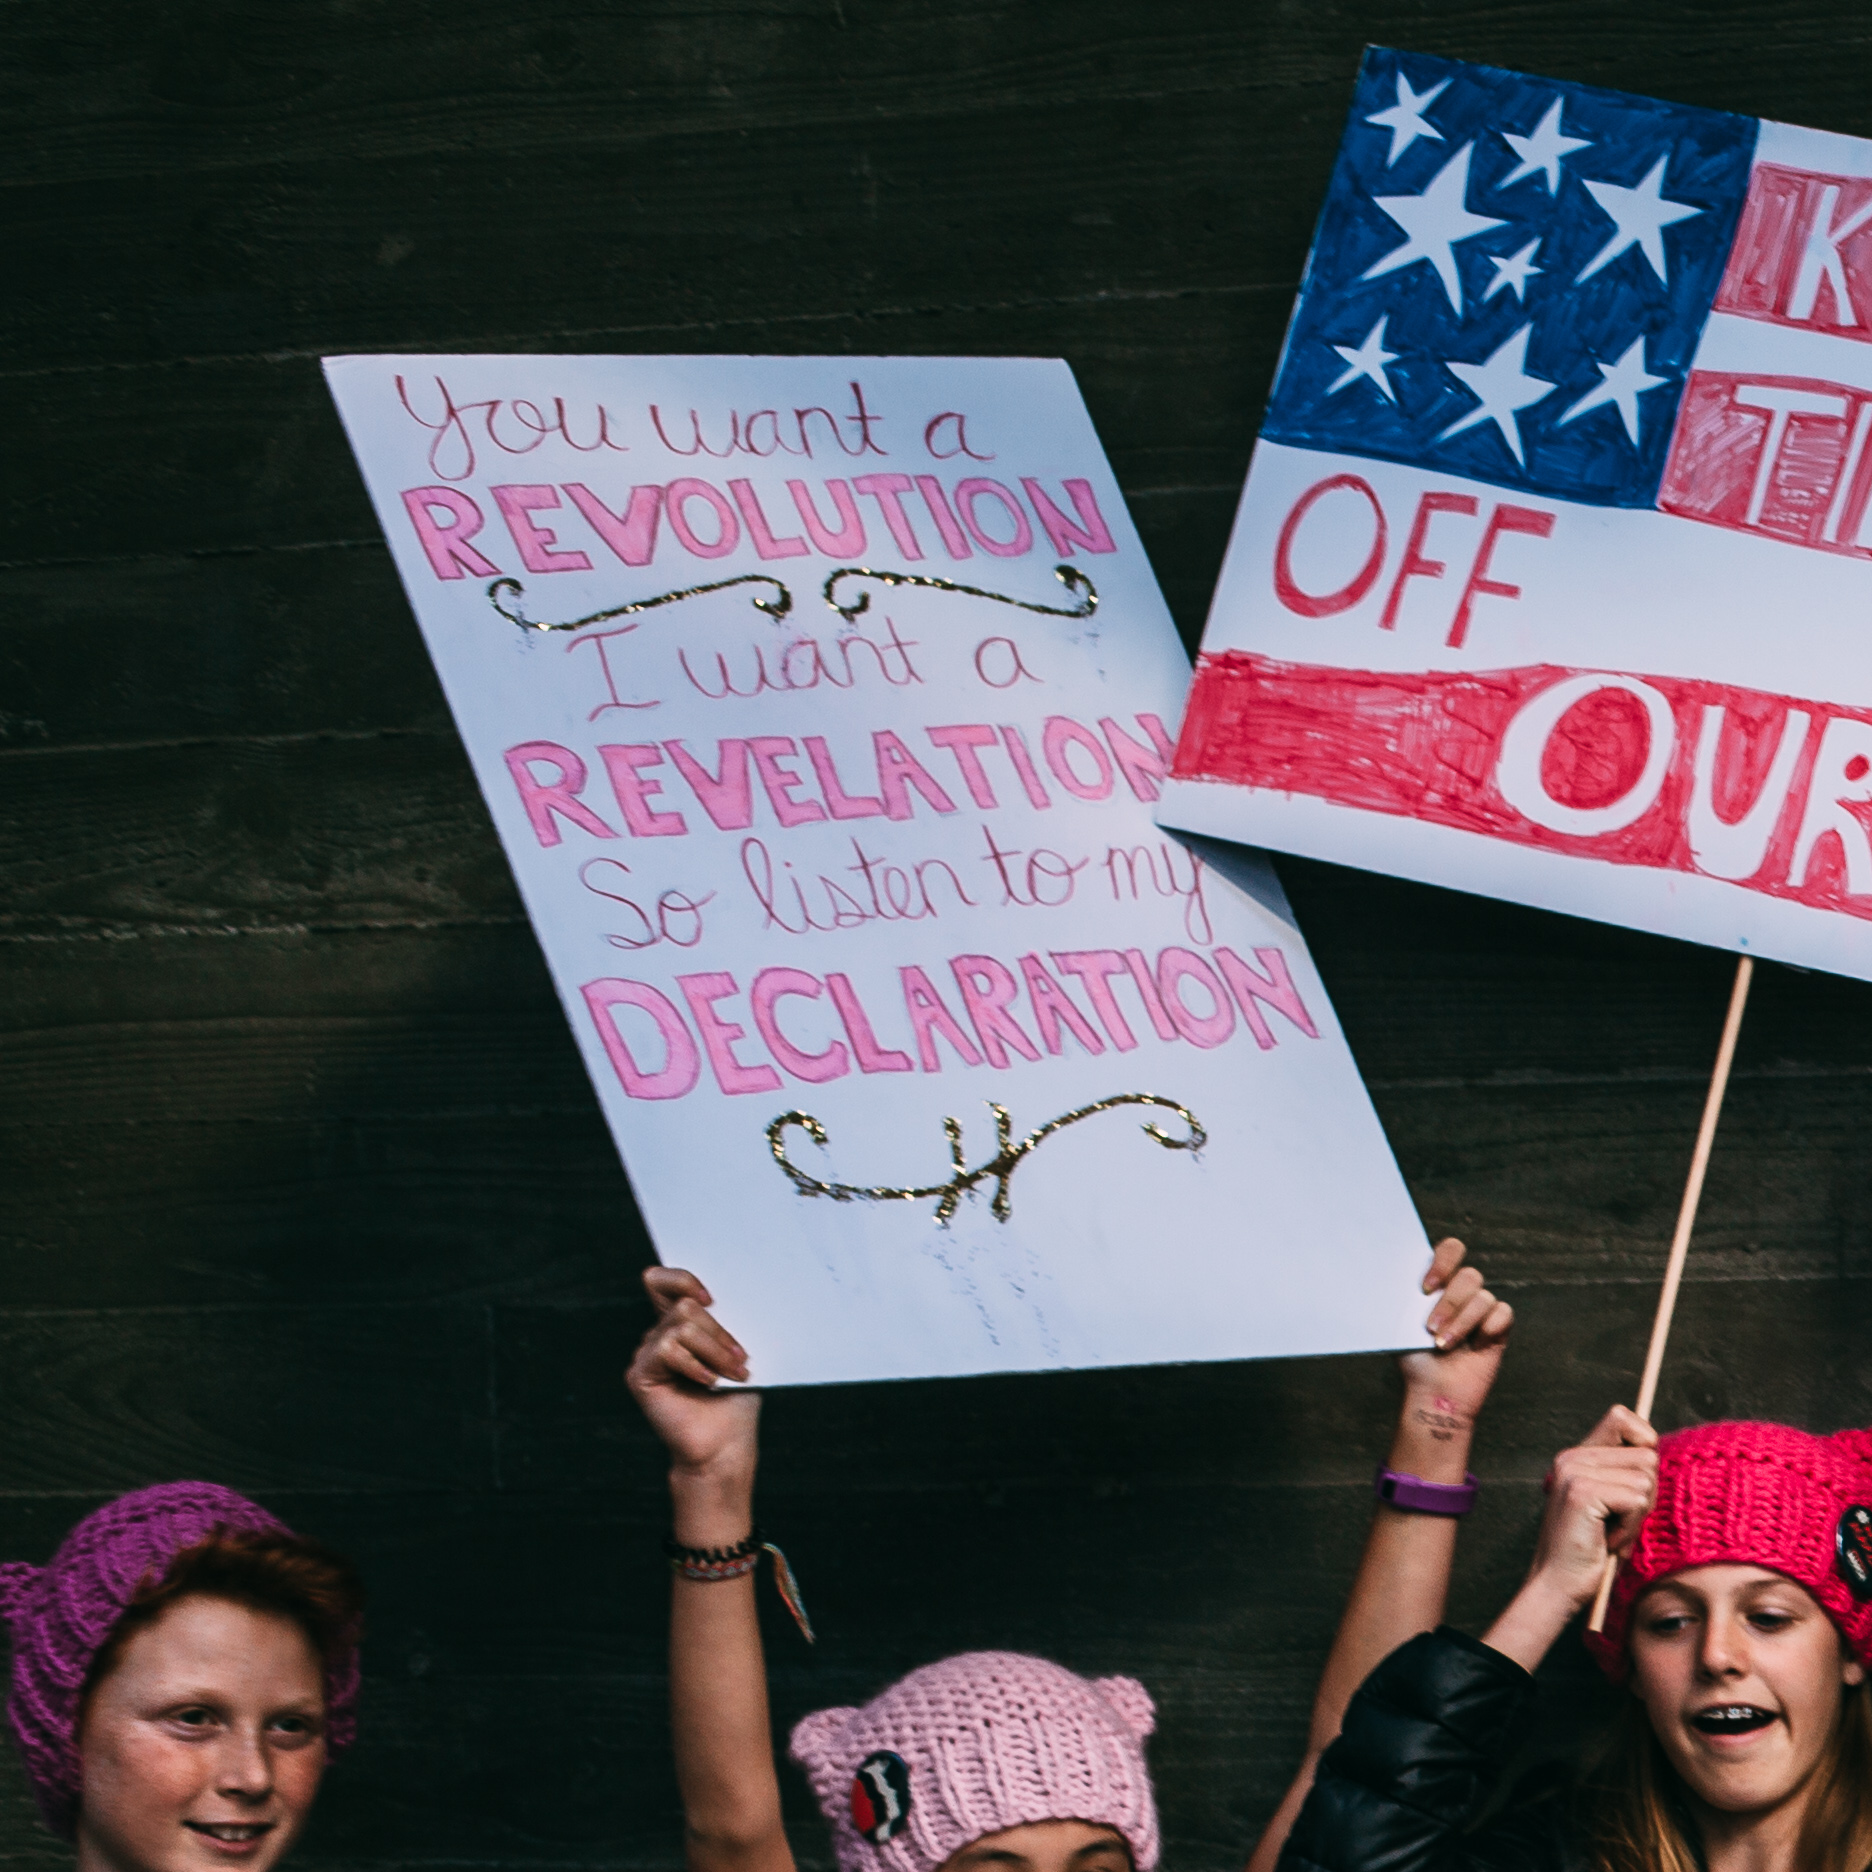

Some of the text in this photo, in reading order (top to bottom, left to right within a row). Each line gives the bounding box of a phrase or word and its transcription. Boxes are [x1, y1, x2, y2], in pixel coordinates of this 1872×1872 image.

[395, 374, 998, 482] You want a
[400, 474, 1120, 582] REVOLUTION
[1272, 472, 1557, 650] OFF
[565, 616, 1046, 723] I want a
[501, 711, 1177, 848] REVELATION
[577, 823, 1214, 953] So listen to my
[579, 945, 1323, 1102] DECLARATION
